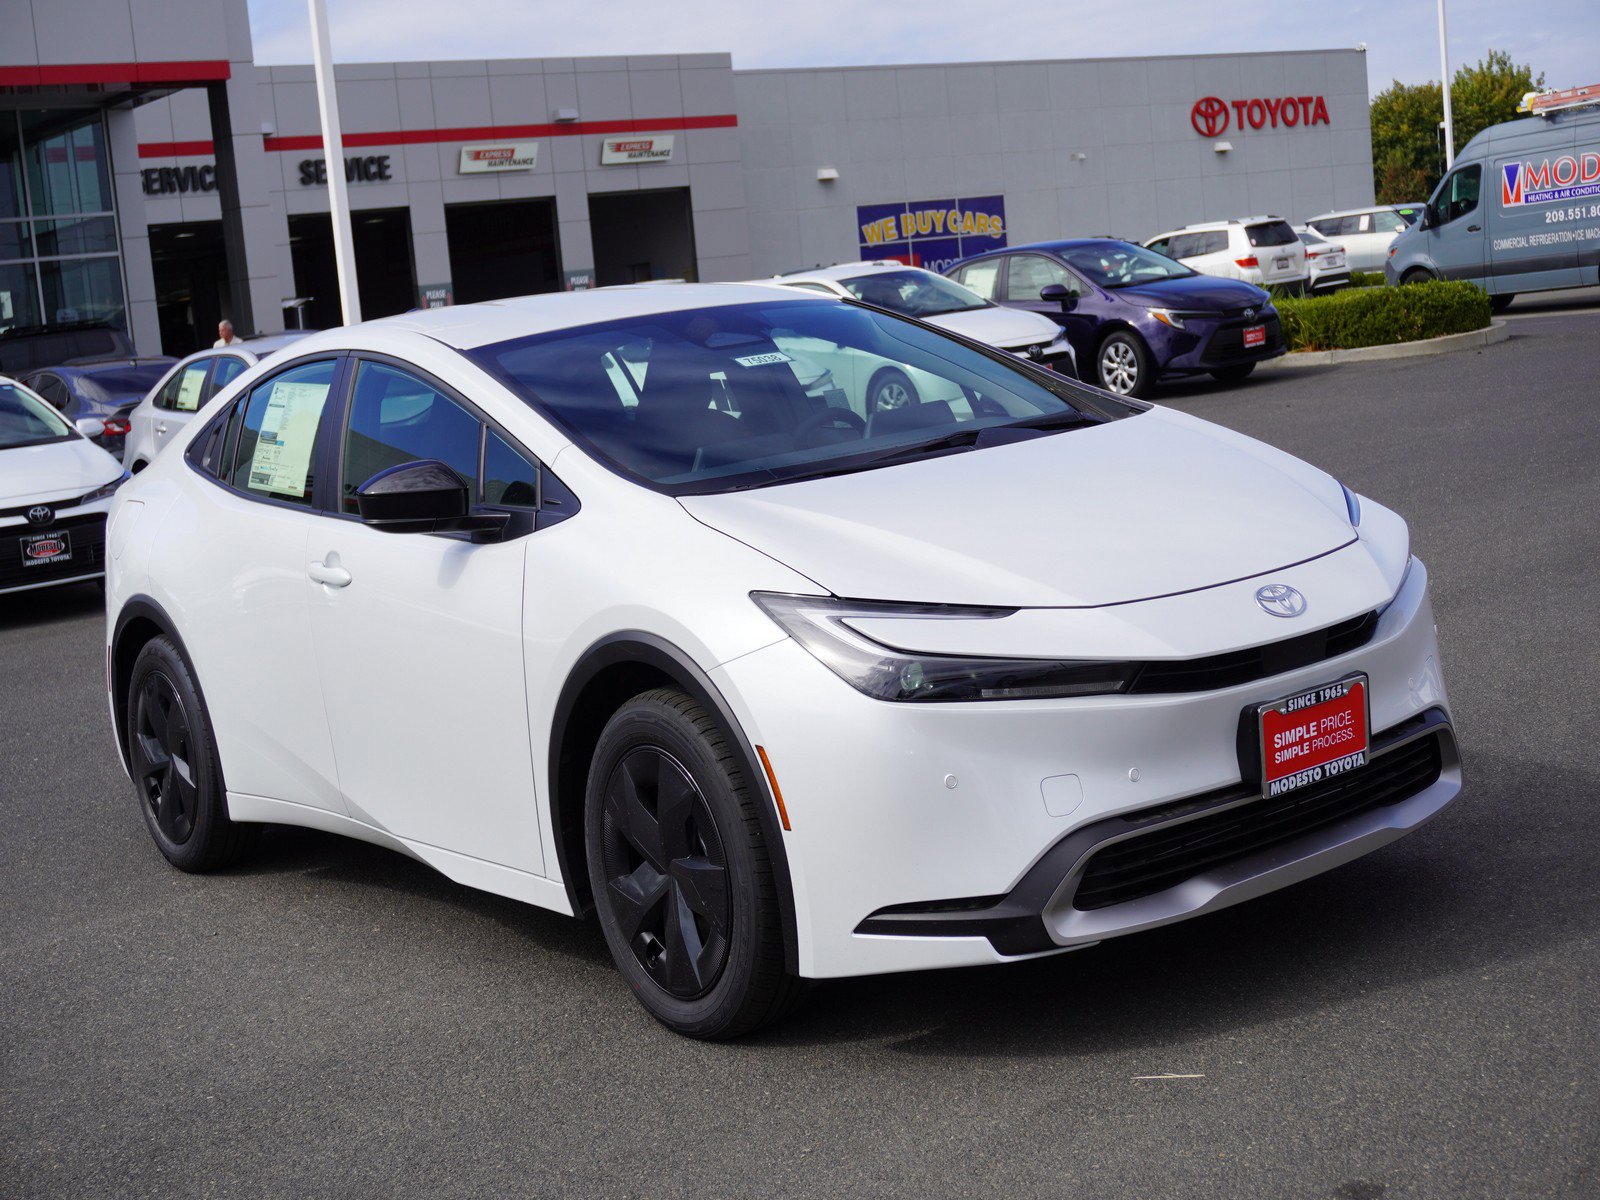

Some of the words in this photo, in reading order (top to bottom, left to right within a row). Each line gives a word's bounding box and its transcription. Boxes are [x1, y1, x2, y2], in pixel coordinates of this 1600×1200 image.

[1231, 96, 1330, 130] TOYOTA
[479, 150, 512, 159] EXPRESS
[619, 141, 651, 151] EXPRESS
[627, 149, 671, 159] MAINTENANCE
[299, 156, 392, 186] SEVICE
[487, 158, 534, 167] MAINTENANCE
[141, 165, 219, 195] ERVIC
[1528, 192, 1554, 202] HEATING
[1554, 191, 1559, 199] &
[1560, 189, 1570, 198] AIR
[861, 216, 898, 246] WE
[900, 209, 947, 237] BUY
[947, 209, 1003, 239] CARS
[1493, 236, 1529, 251] COMMERCIAL
[426, 289, 446, 300] PLEASE
[1288, 692, 1316, 712] SINCE
[1320, 685, 1342, 702] 1965
[1274, 722, 1317, 748] SIMPLE
[1320, 710, 1355, 733] PRICE.
[1274, 742, 1310, 764] SIMPLE
[1312, 728, 1355, 751] PROCESS.
[1270, 767, 1321, 796] MODESTO
[1324, 753, 1365, 777] TOYOTA
